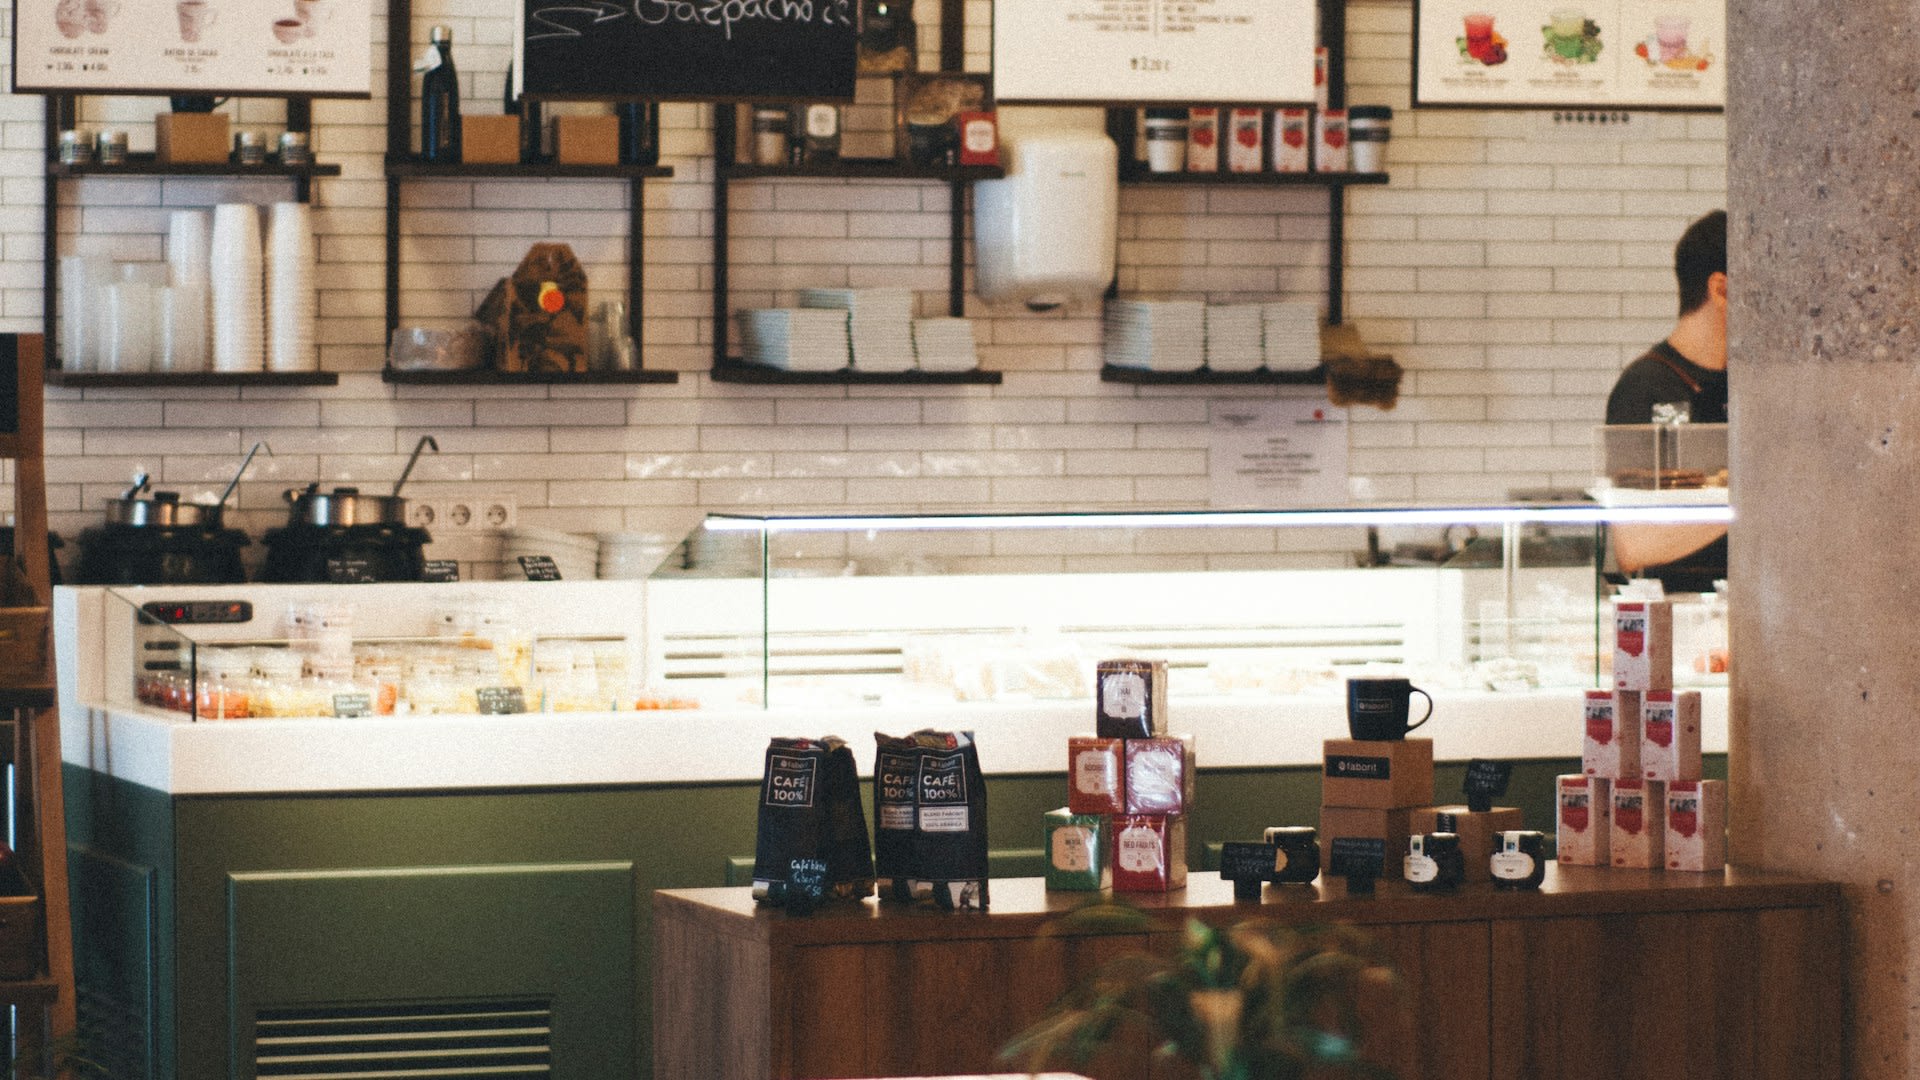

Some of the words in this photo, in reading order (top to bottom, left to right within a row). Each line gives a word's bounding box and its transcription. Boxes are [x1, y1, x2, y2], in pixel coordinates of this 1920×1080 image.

[1346, 762, 1377, 773] faborit
[773, 774, 805, 788] CAFÉ
[922, 772, 956, 787] CAFÉ
[773, 789, 804, 801] 100%
[923, 787, 958, 800] 100%
[1123, 840, 1135, 849] RED
